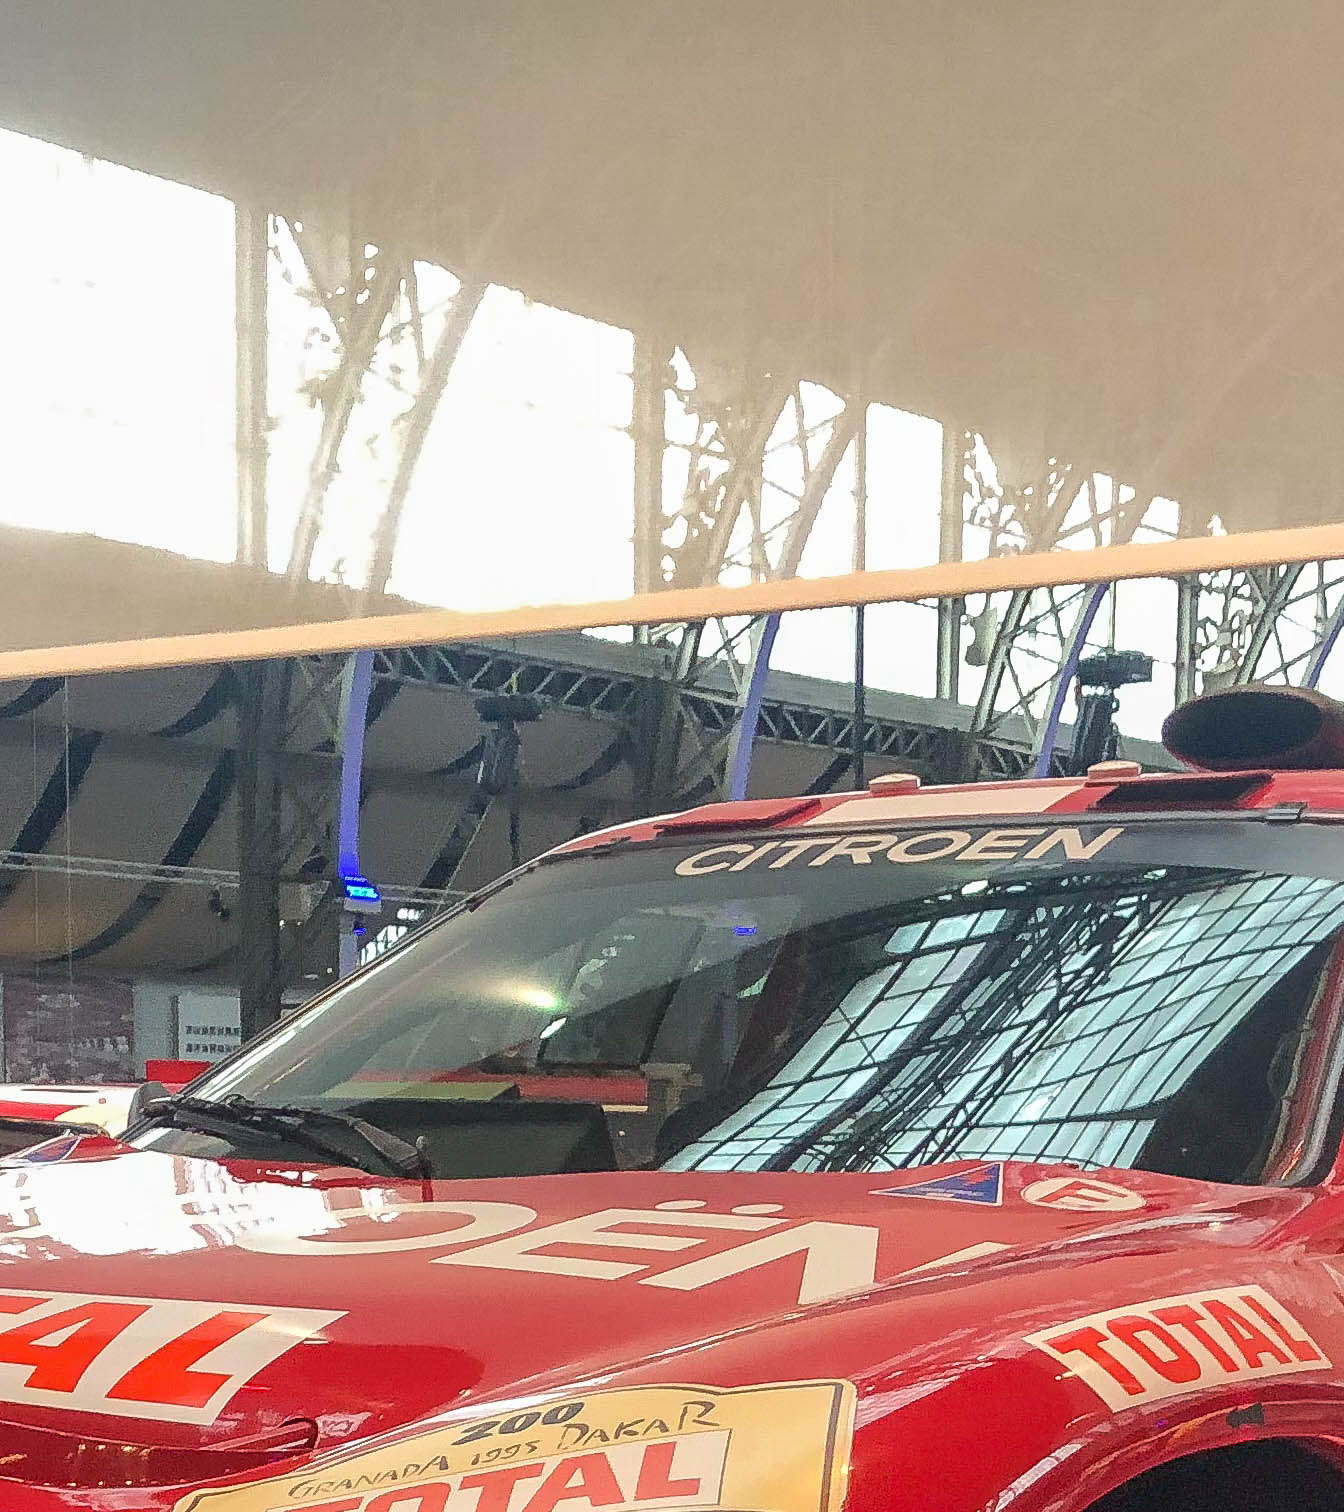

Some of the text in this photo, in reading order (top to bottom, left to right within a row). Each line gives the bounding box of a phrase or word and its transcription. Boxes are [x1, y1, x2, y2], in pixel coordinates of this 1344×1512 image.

[1056, 1294, 1324, 1397] TOTAL
[288, 1401, 721, 1499] GRANADA 1995 DAKAR
[451, 1402, 584, 1446] 200
